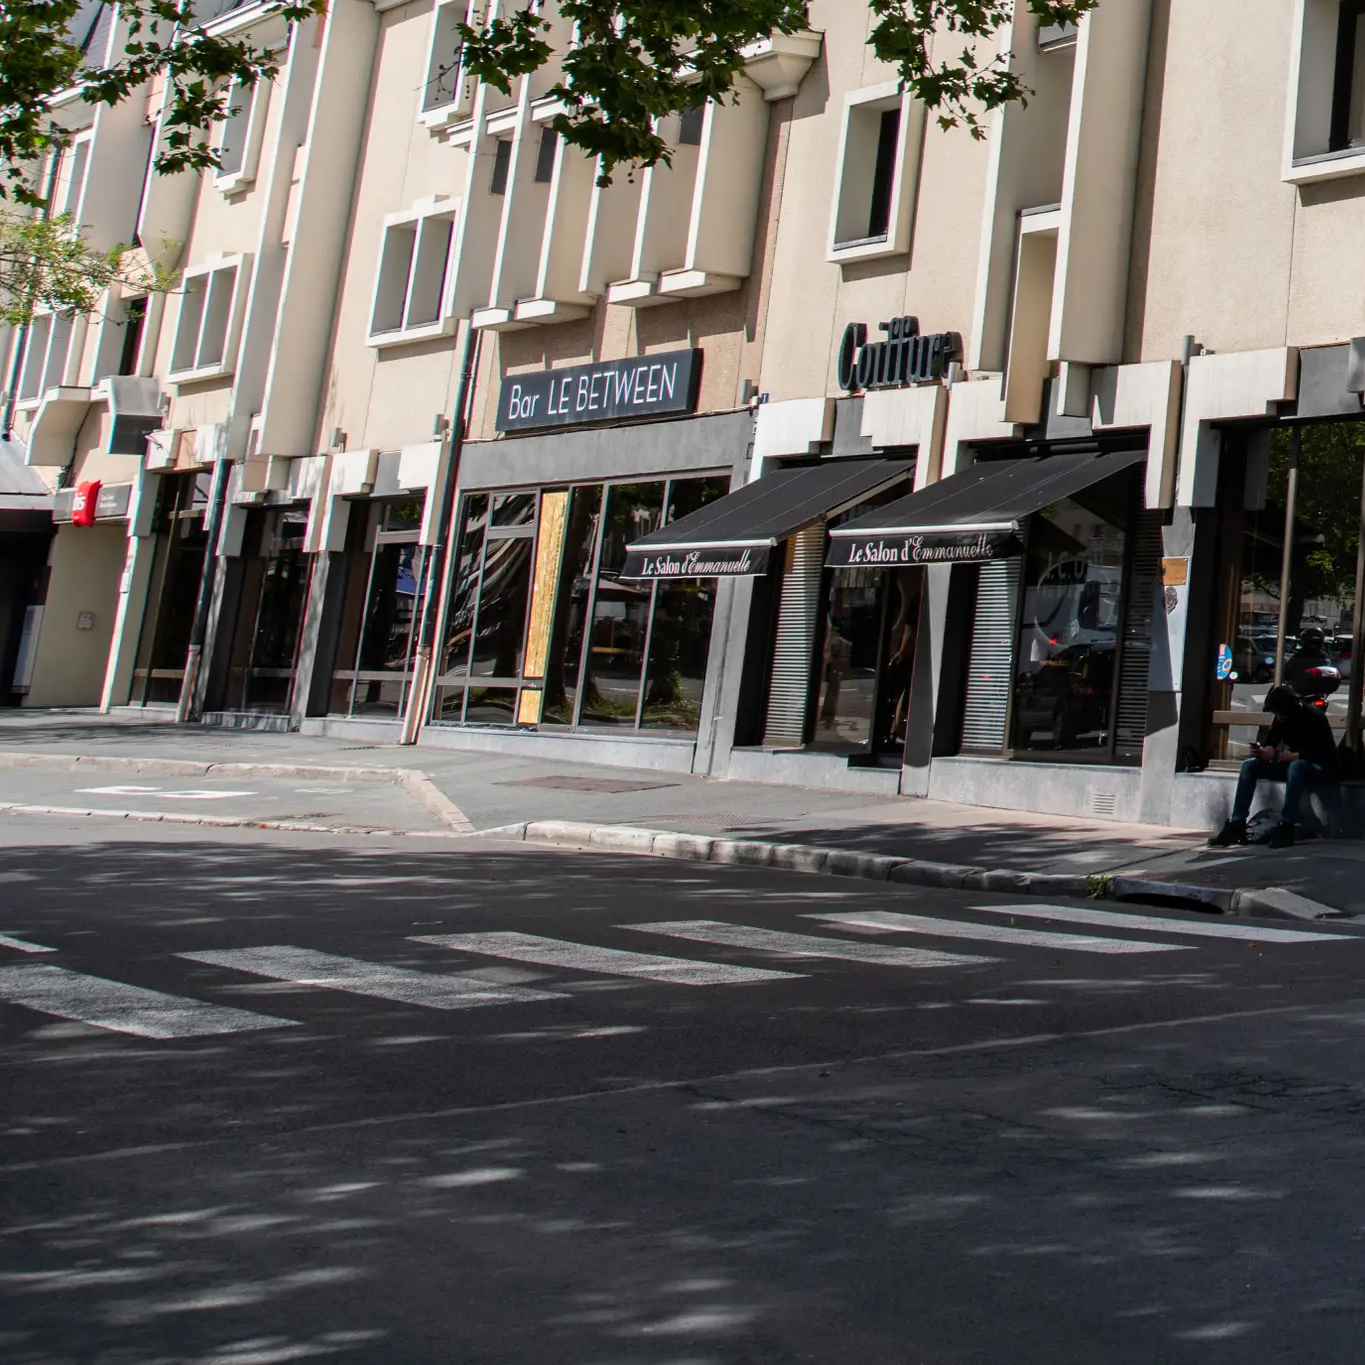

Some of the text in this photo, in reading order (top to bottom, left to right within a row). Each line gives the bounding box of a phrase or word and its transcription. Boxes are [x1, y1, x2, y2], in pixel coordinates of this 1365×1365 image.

[838, 316, 963, 390] Coiffure
[508, 362, 678, 420] Bar LE BETWEEN
[641, 549, 751, 575] Le Salon d'Emmanuelle
[848, 543, 863, 563] Le
[863, 541, 898, 562] Salon
